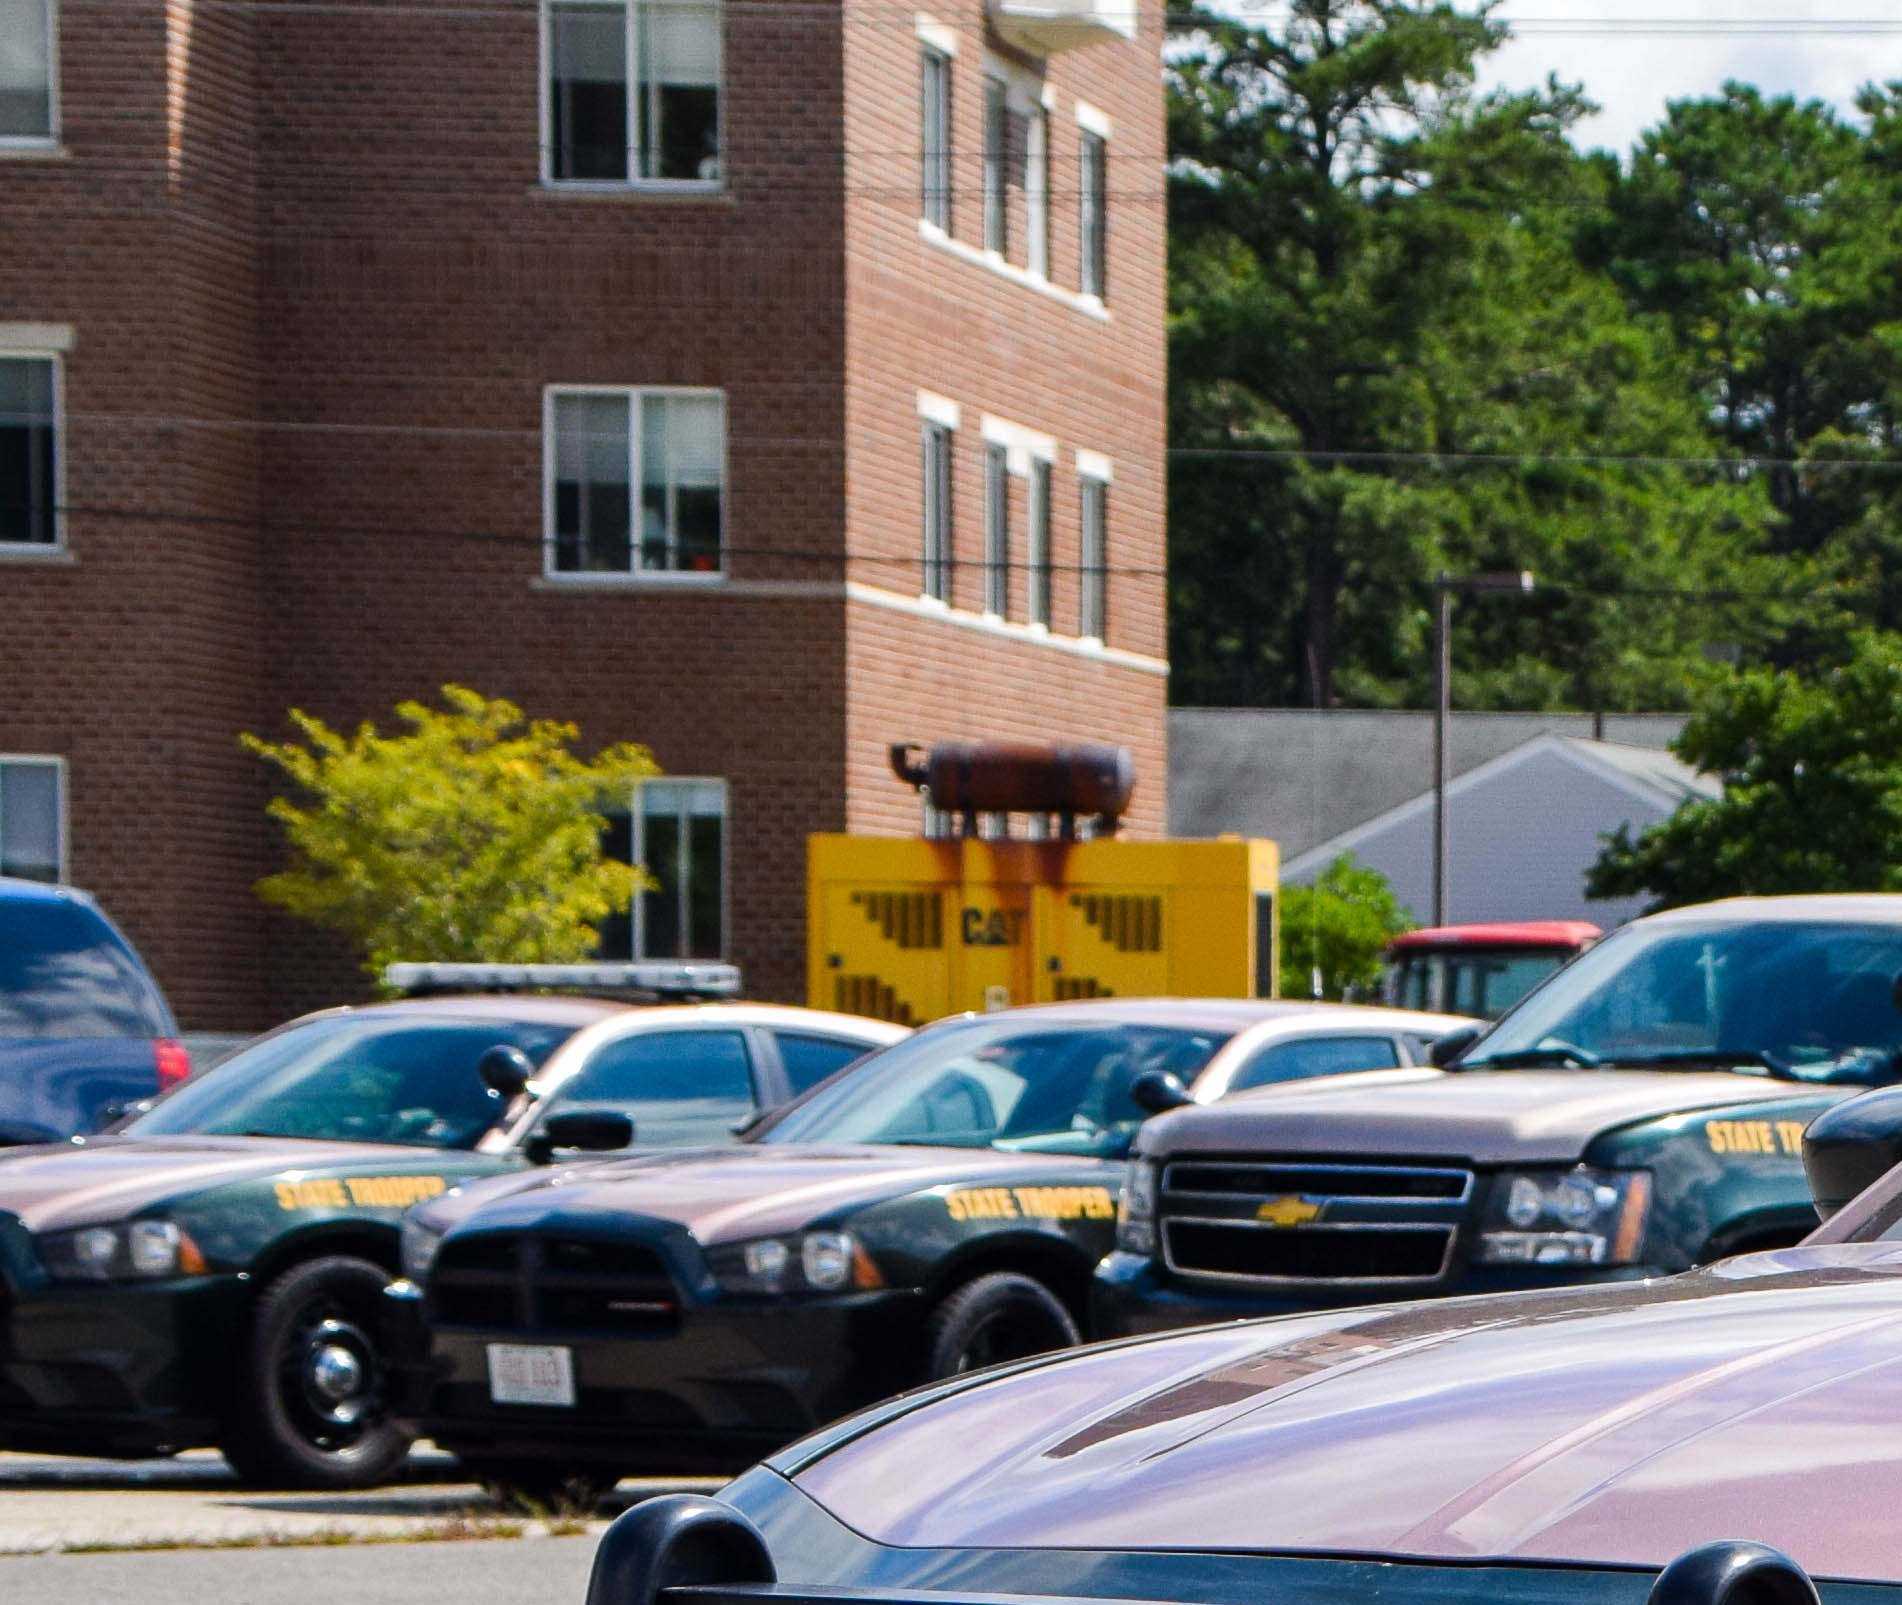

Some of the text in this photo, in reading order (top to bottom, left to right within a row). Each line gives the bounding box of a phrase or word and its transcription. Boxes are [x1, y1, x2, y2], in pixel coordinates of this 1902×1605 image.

[962, 907, 1027, 945] CAT
[1706, 1120, 1776, 1154] STATE
[274, 1178, 349, 1211] STATE
[945, 1185, 1115, 1221] STATE TROOPER
